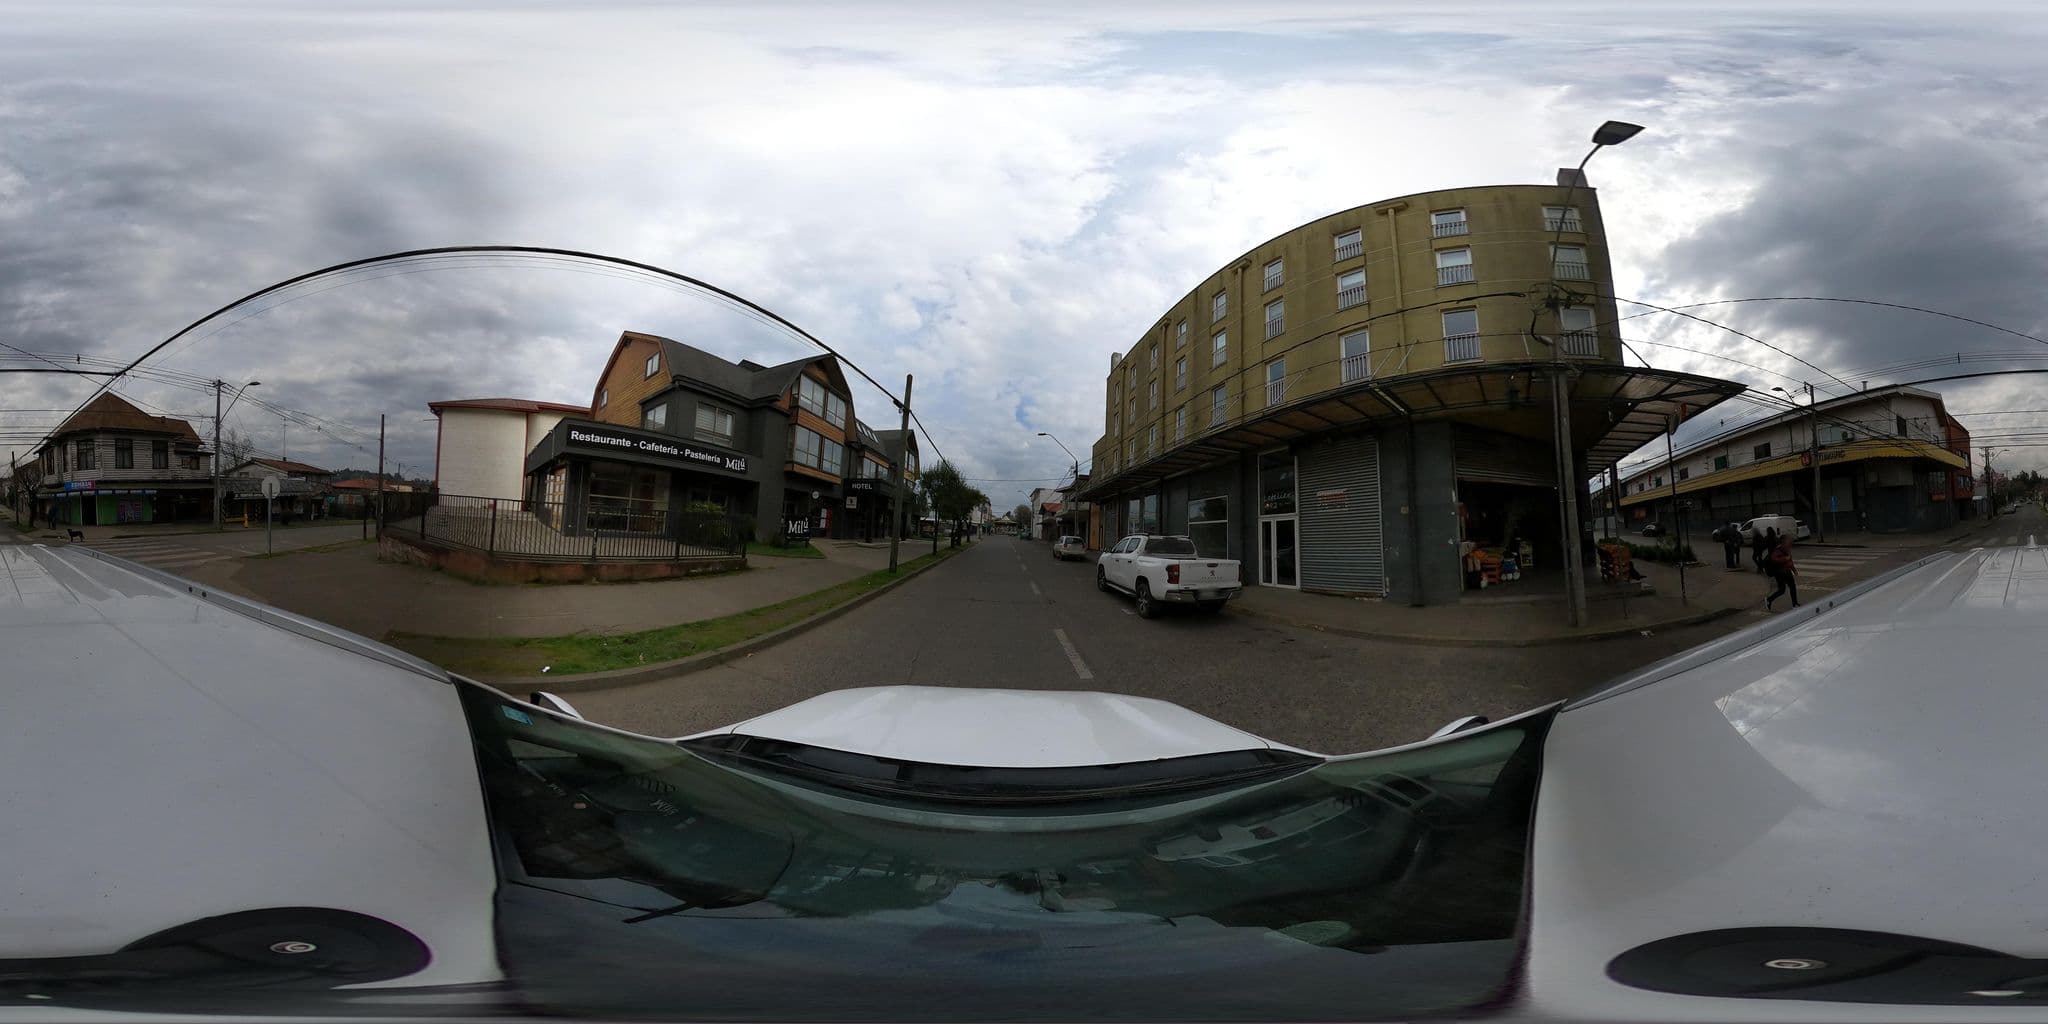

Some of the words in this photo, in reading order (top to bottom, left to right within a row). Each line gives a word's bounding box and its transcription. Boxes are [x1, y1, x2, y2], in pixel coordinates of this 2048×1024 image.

[570, 430, 632, 447] Restaurante
[639, 440, 678, 455] Cafetería
[684, 448, 721, 464] Pastelería
[851, 482, 873, 490] HOTEL
[787, 516, 809, 534] Milú
